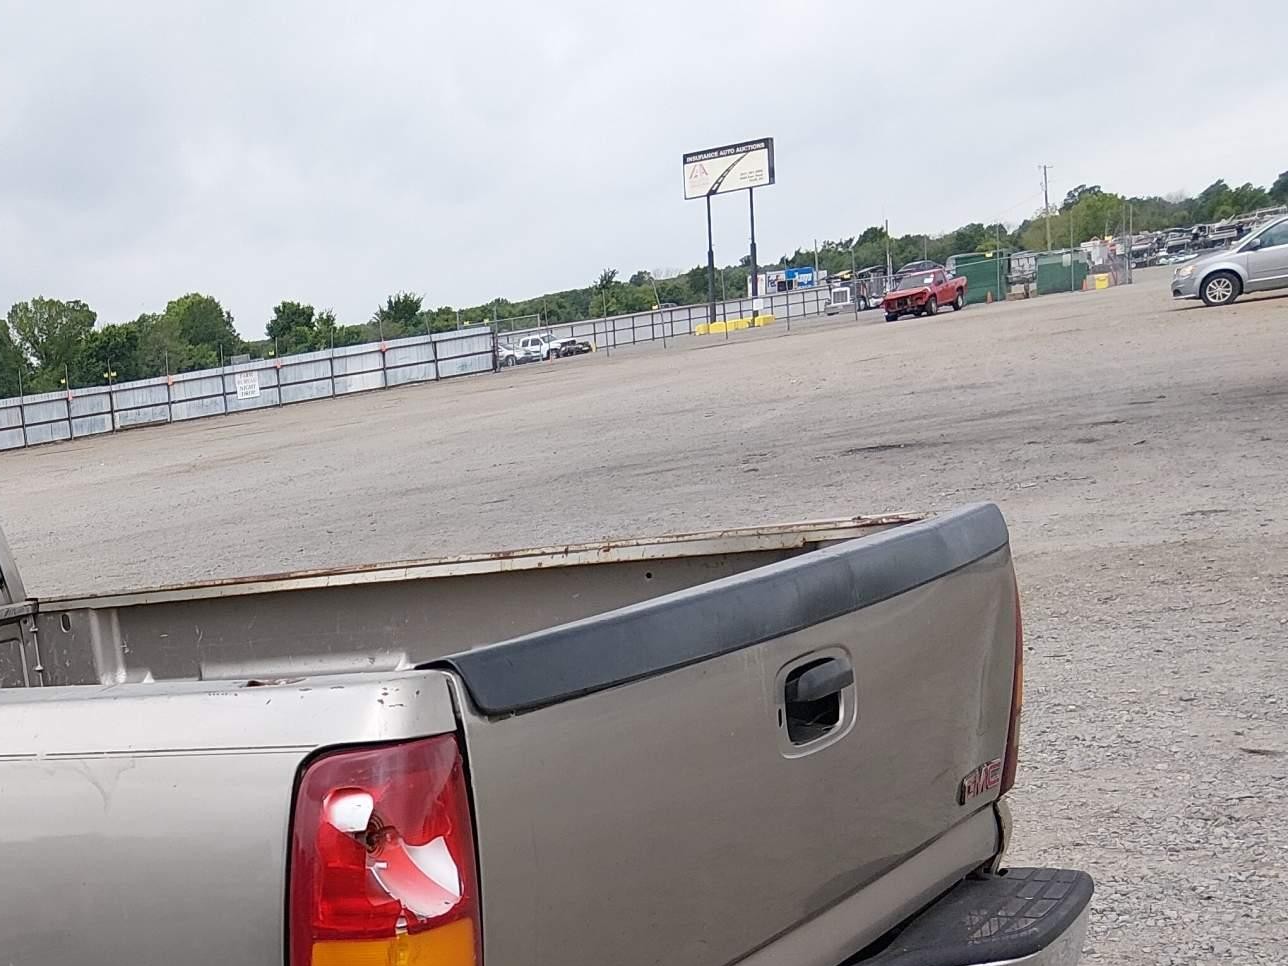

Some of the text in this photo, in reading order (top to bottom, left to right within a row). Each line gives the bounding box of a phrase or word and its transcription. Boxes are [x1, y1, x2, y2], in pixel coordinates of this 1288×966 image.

[686, 142, 765, 163] INSURANCE AUTO AUCTIONS
[962, 758, 1001, 801] GMC
